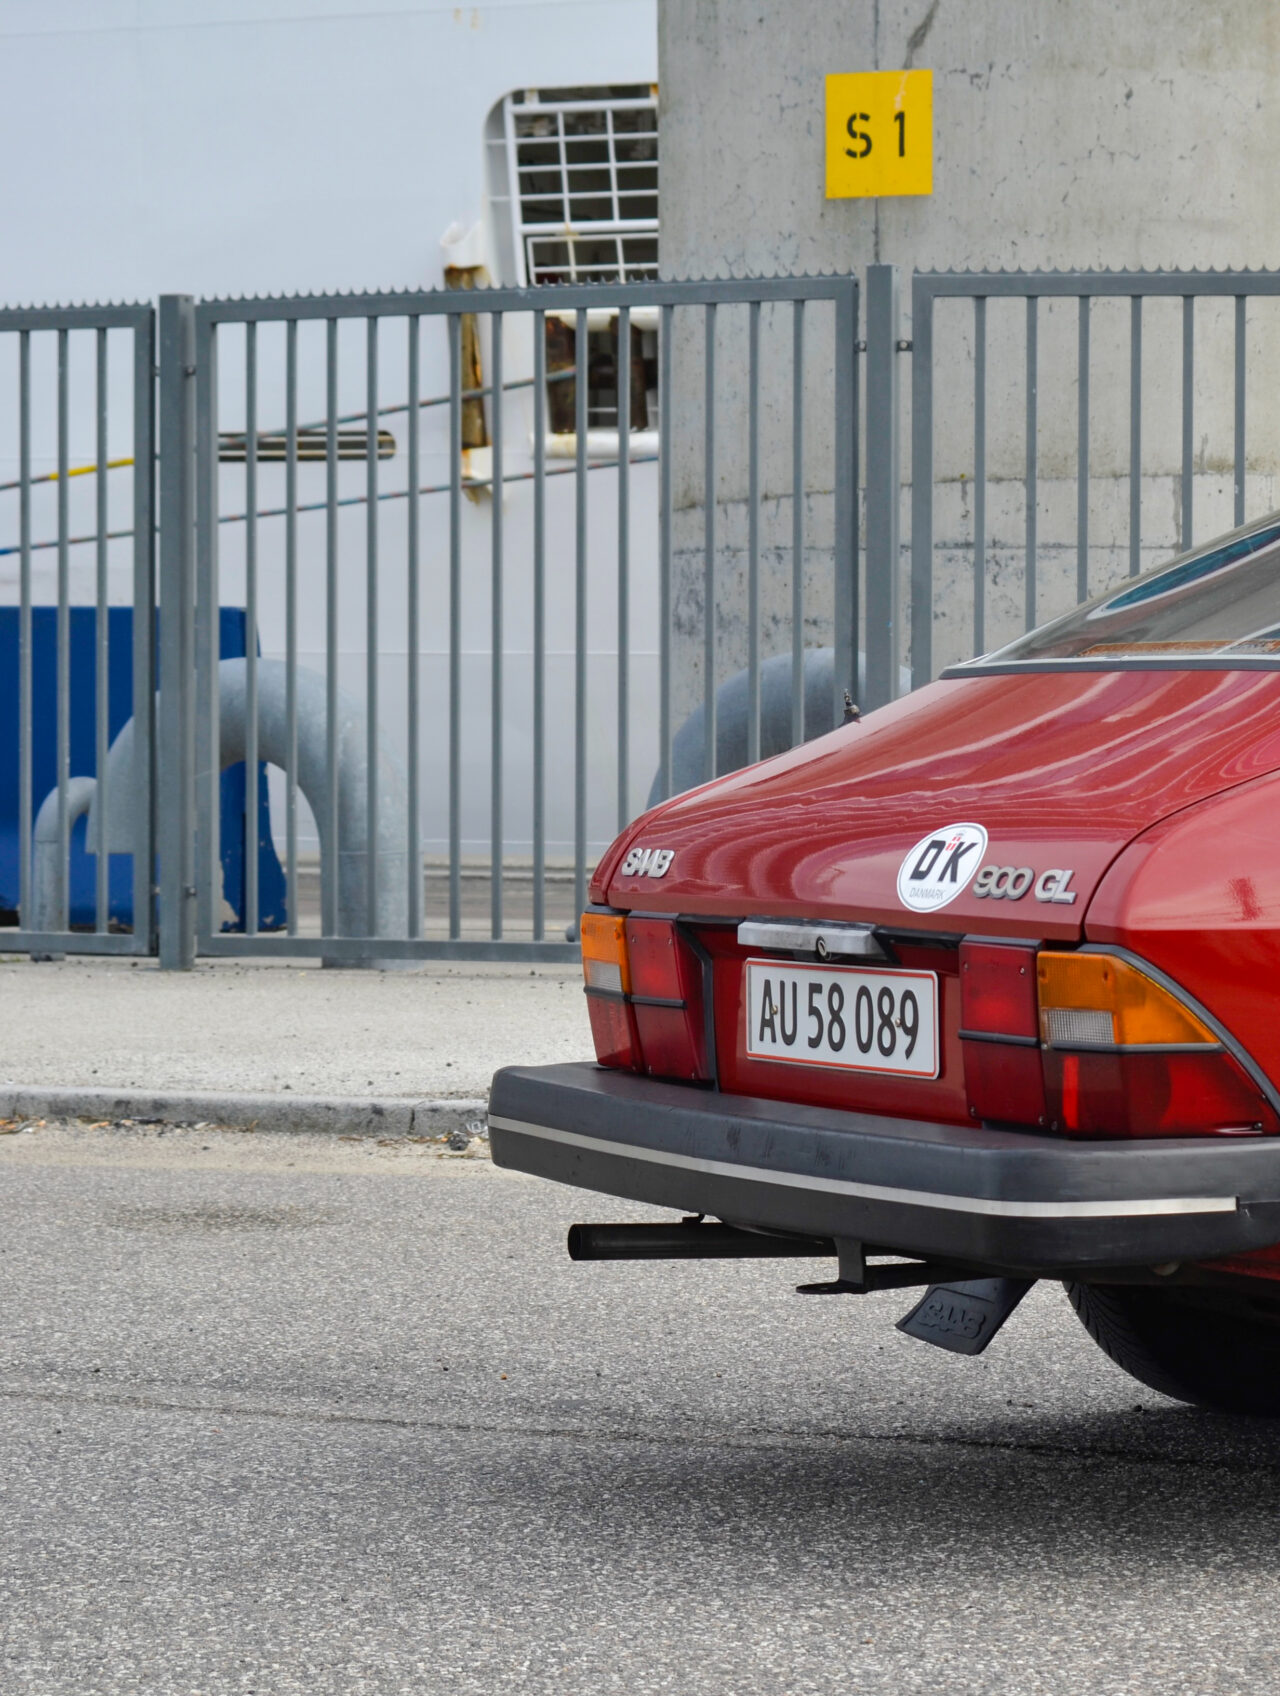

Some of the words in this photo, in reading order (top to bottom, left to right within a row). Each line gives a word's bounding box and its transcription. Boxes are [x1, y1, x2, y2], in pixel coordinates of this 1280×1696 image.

[844, 112, 872, 159] S
[894, 111, 905, 157] 1
[621, 847, 675, 878] SAAB
[909, 839, 978, 884] DK
[909, 886, 946, 900] DANMARK
[973, 865, 1033, 899] 900
[1034, 869, 1076, 904] GL
[759, 979, 797, 1045] AU
[808, 982, 845, 1052] 58
[855, 985, 918, 1060] 089
